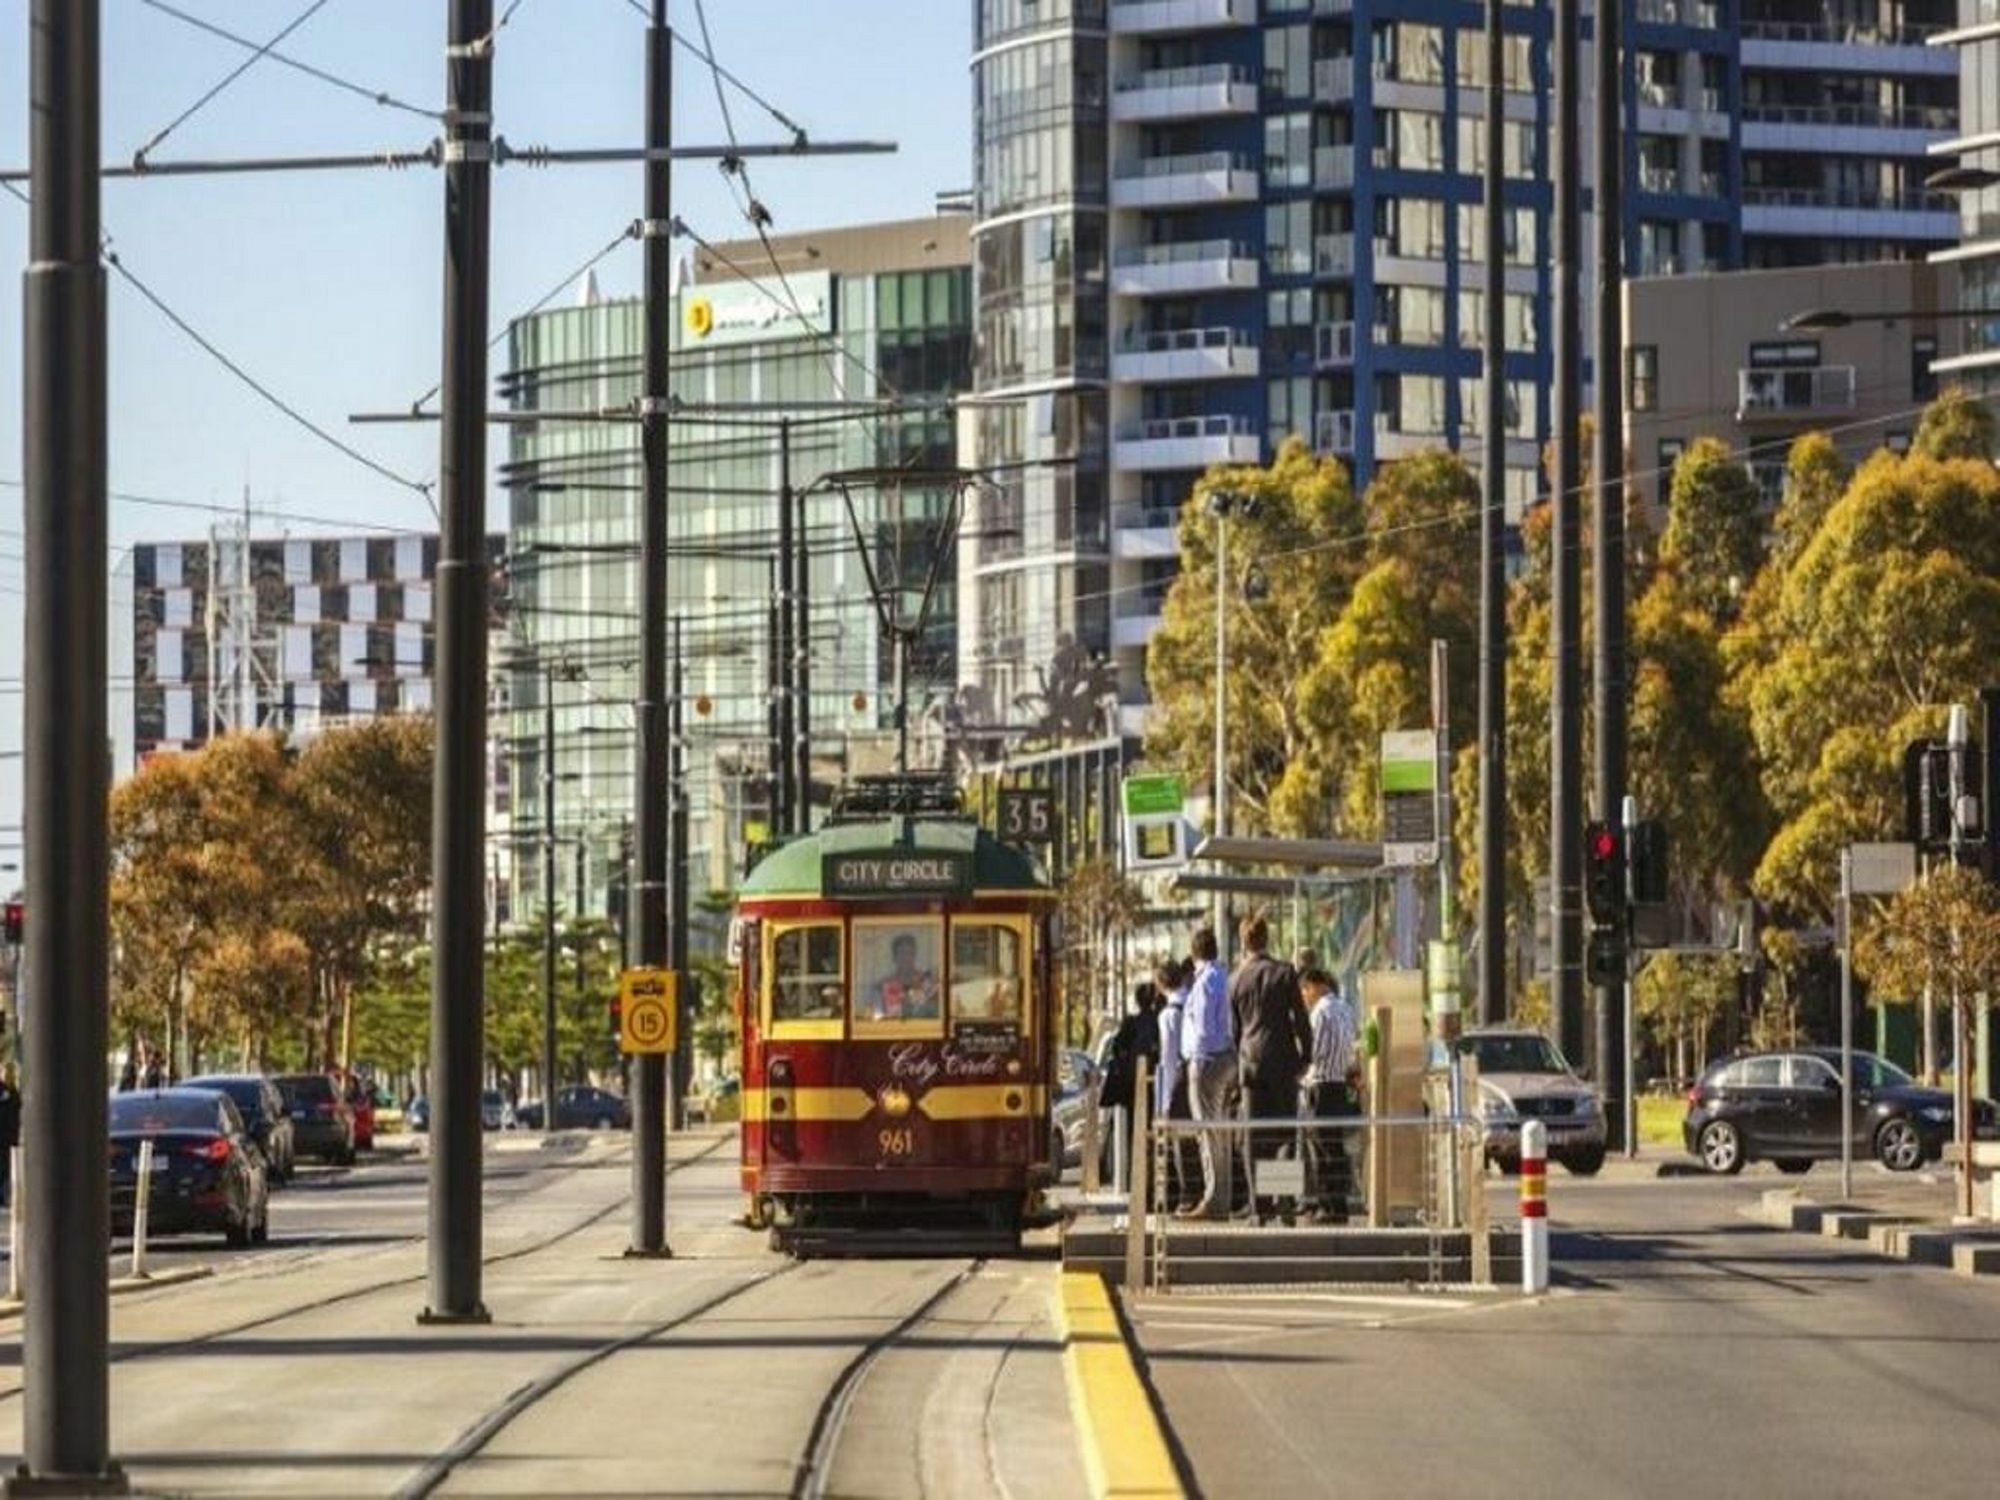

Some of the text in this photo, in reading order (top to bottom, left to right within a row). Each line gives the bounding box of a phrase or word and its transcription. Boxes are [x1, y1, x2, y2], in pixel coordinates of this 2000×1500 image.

[1008, 799, 1048, 833] 35
[841, 859, 954, 881] CITY CIRCLE
[640, 1013, 658, 1034] 15
[888, 1042, 939, 1084] City
[940, 1043, 998, 1075] Circle
[879, 1129, 912, 1156] 961
